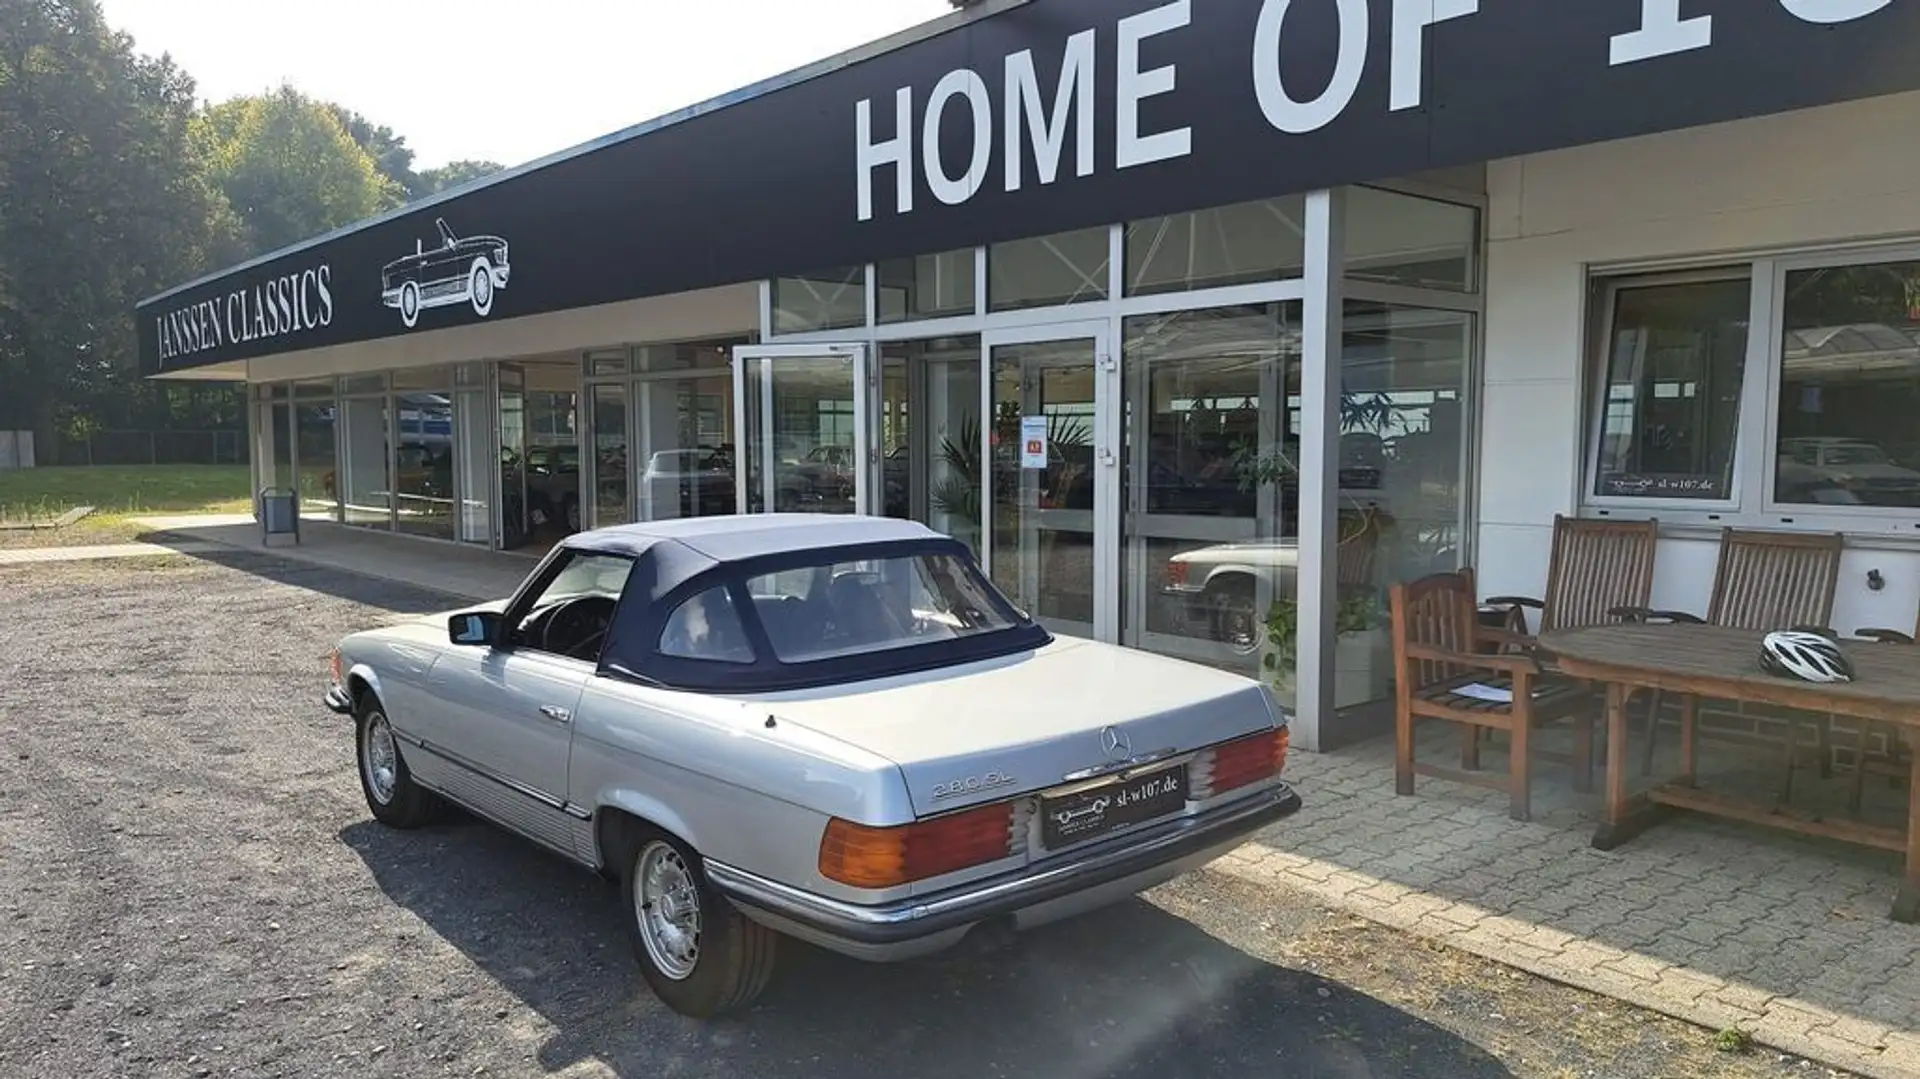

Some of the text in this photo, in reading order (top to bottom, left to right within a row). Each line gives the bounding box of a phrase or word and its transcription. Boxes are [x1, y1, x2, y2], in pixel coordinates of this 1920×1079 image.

[856, 0, 1191, 221] HOME
[157, 264, 333, 369] JANSSEN CLASSICS
[1116, 775, 1178, 807] sl-w107.de
